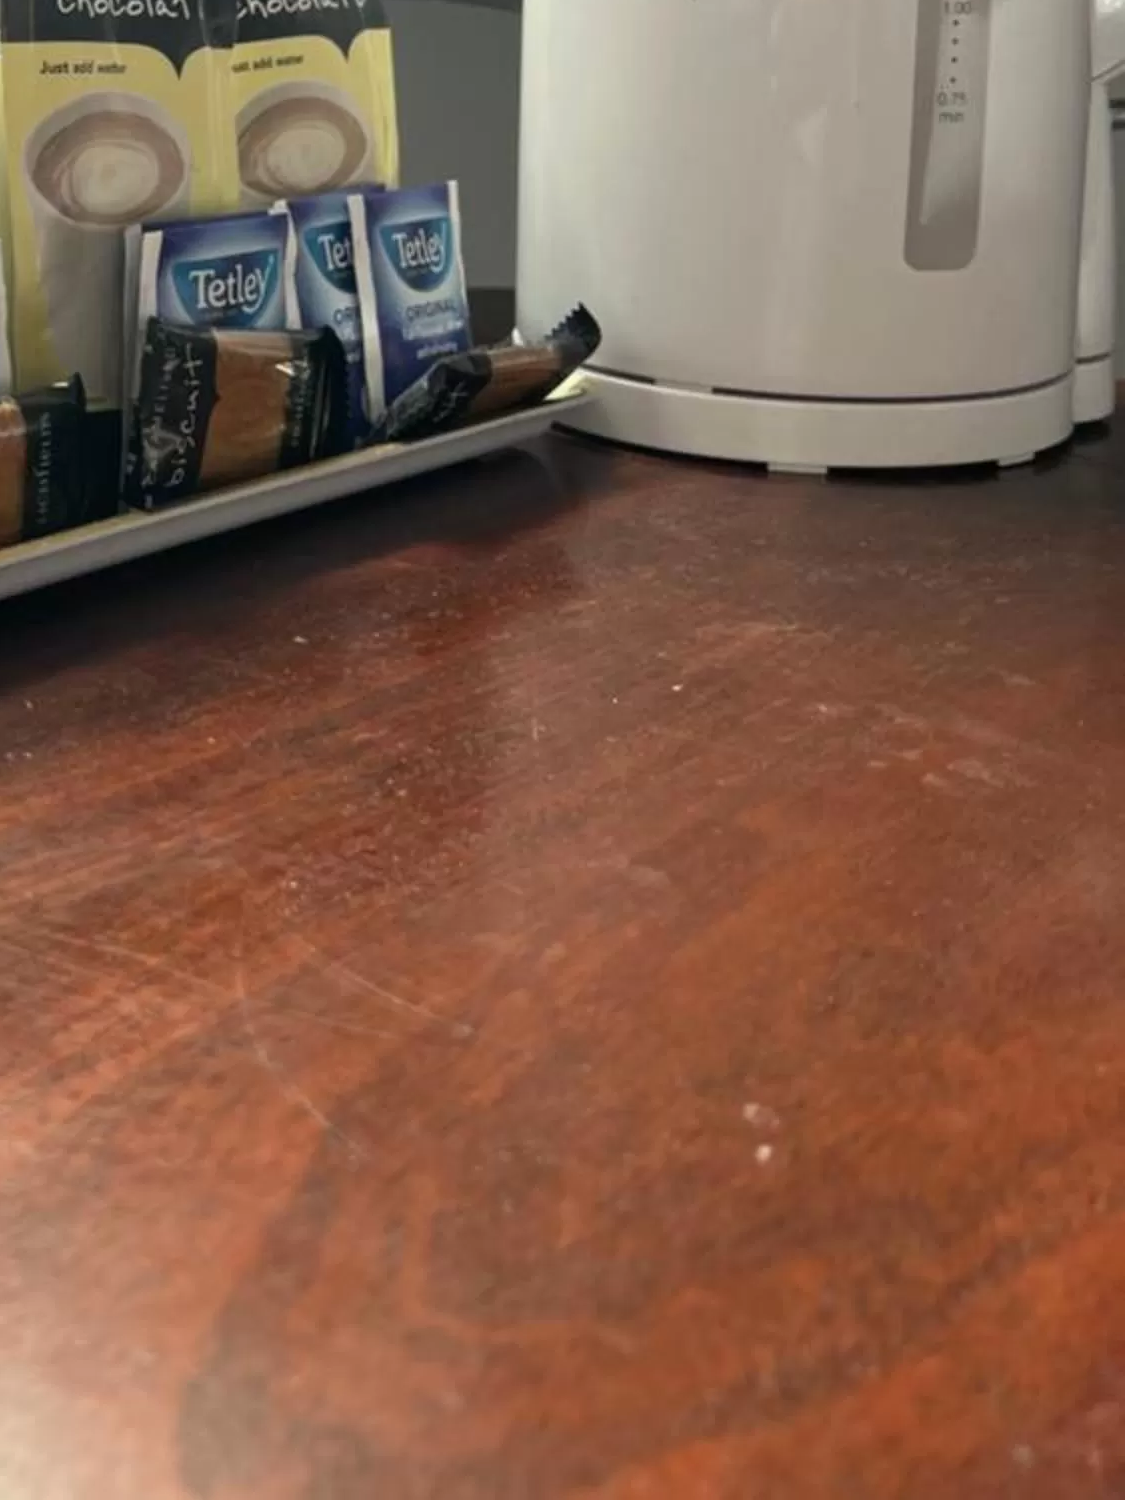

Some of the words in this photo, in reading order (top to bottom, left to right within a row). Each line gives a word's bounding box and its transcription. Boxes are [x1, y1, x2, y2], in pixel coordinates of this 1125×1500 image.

[39, 60, 70, 75] Just
[391, 221, 447, 274] Tetley
[187, 253, 275, 315] Tetley
